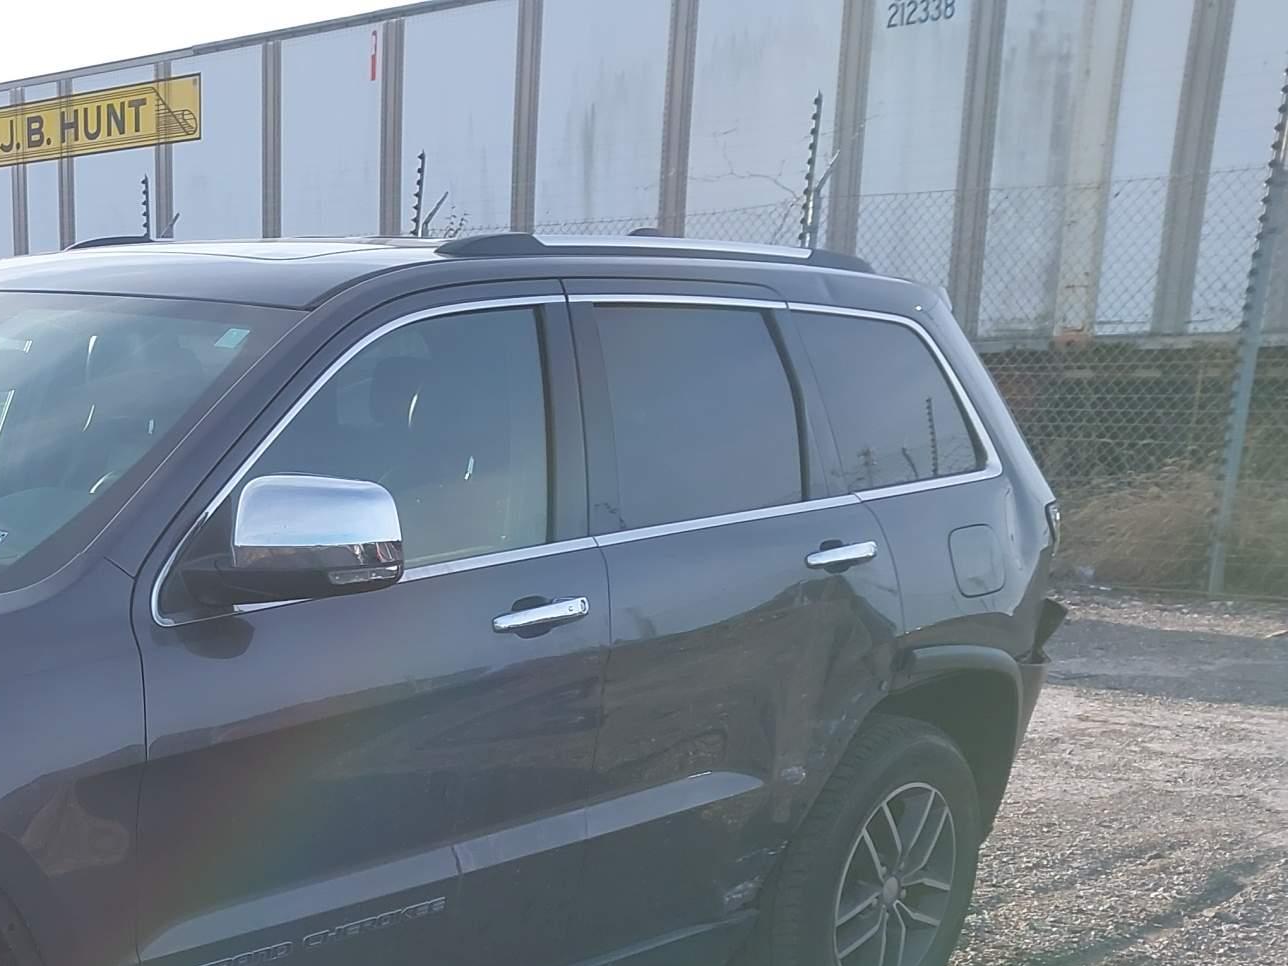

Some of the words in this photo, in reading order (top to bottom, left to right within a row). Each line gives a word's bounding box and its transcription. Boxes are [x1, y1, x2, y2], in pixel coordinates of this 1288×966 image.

[886, 0, 956, 29] 212338
[0, 119, 21, 153] J.
[26, 115, 52, 149] B.
[60, 98, 147, 143] HUNT
